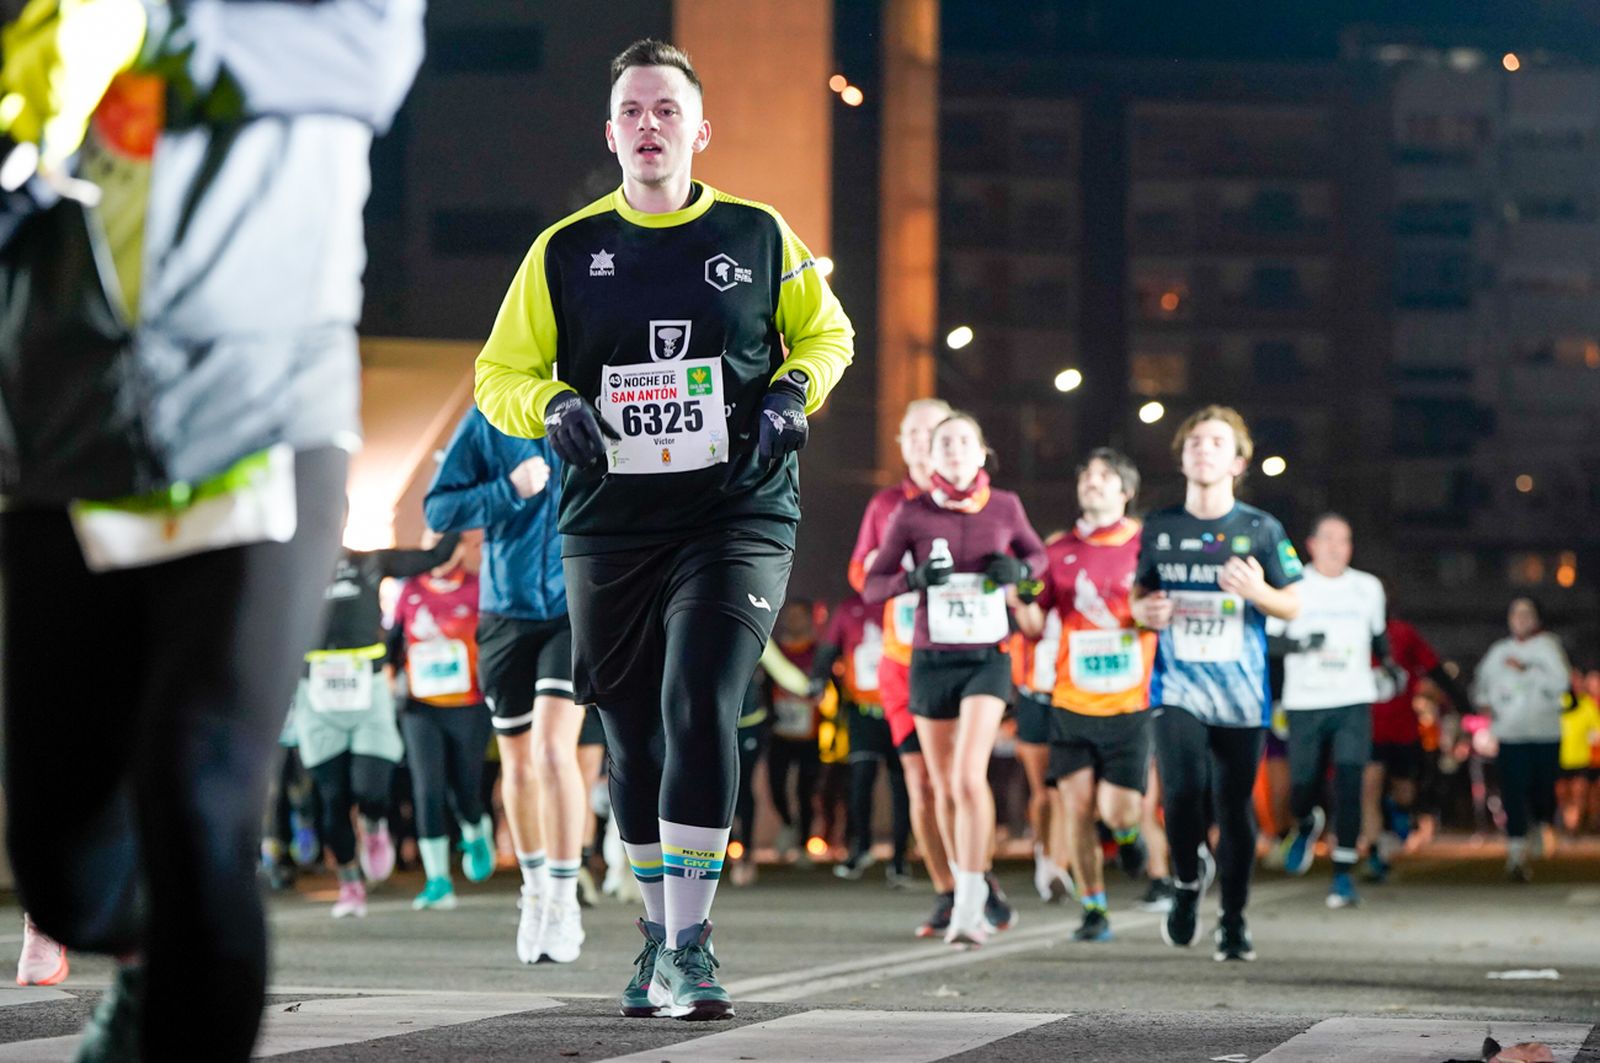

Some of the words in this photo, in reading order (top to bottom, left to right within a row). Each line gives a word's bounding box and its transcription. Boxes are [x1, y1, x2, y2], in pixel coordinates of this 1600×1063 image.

[623, 375, 660, 388] NOCHE
[662, 373, 676, 385] DE
[611, 390, 636, 403] SAN
[637, 385, 678, 402] ANTÓN
[622, 400, 704, 437] 6325
[1184, 617, 1226, 636] 7327
[682, 849, 715, 858] NEVER
[683, 858, 711, 868] GIVE
[683, 868, 707, 880] UP
